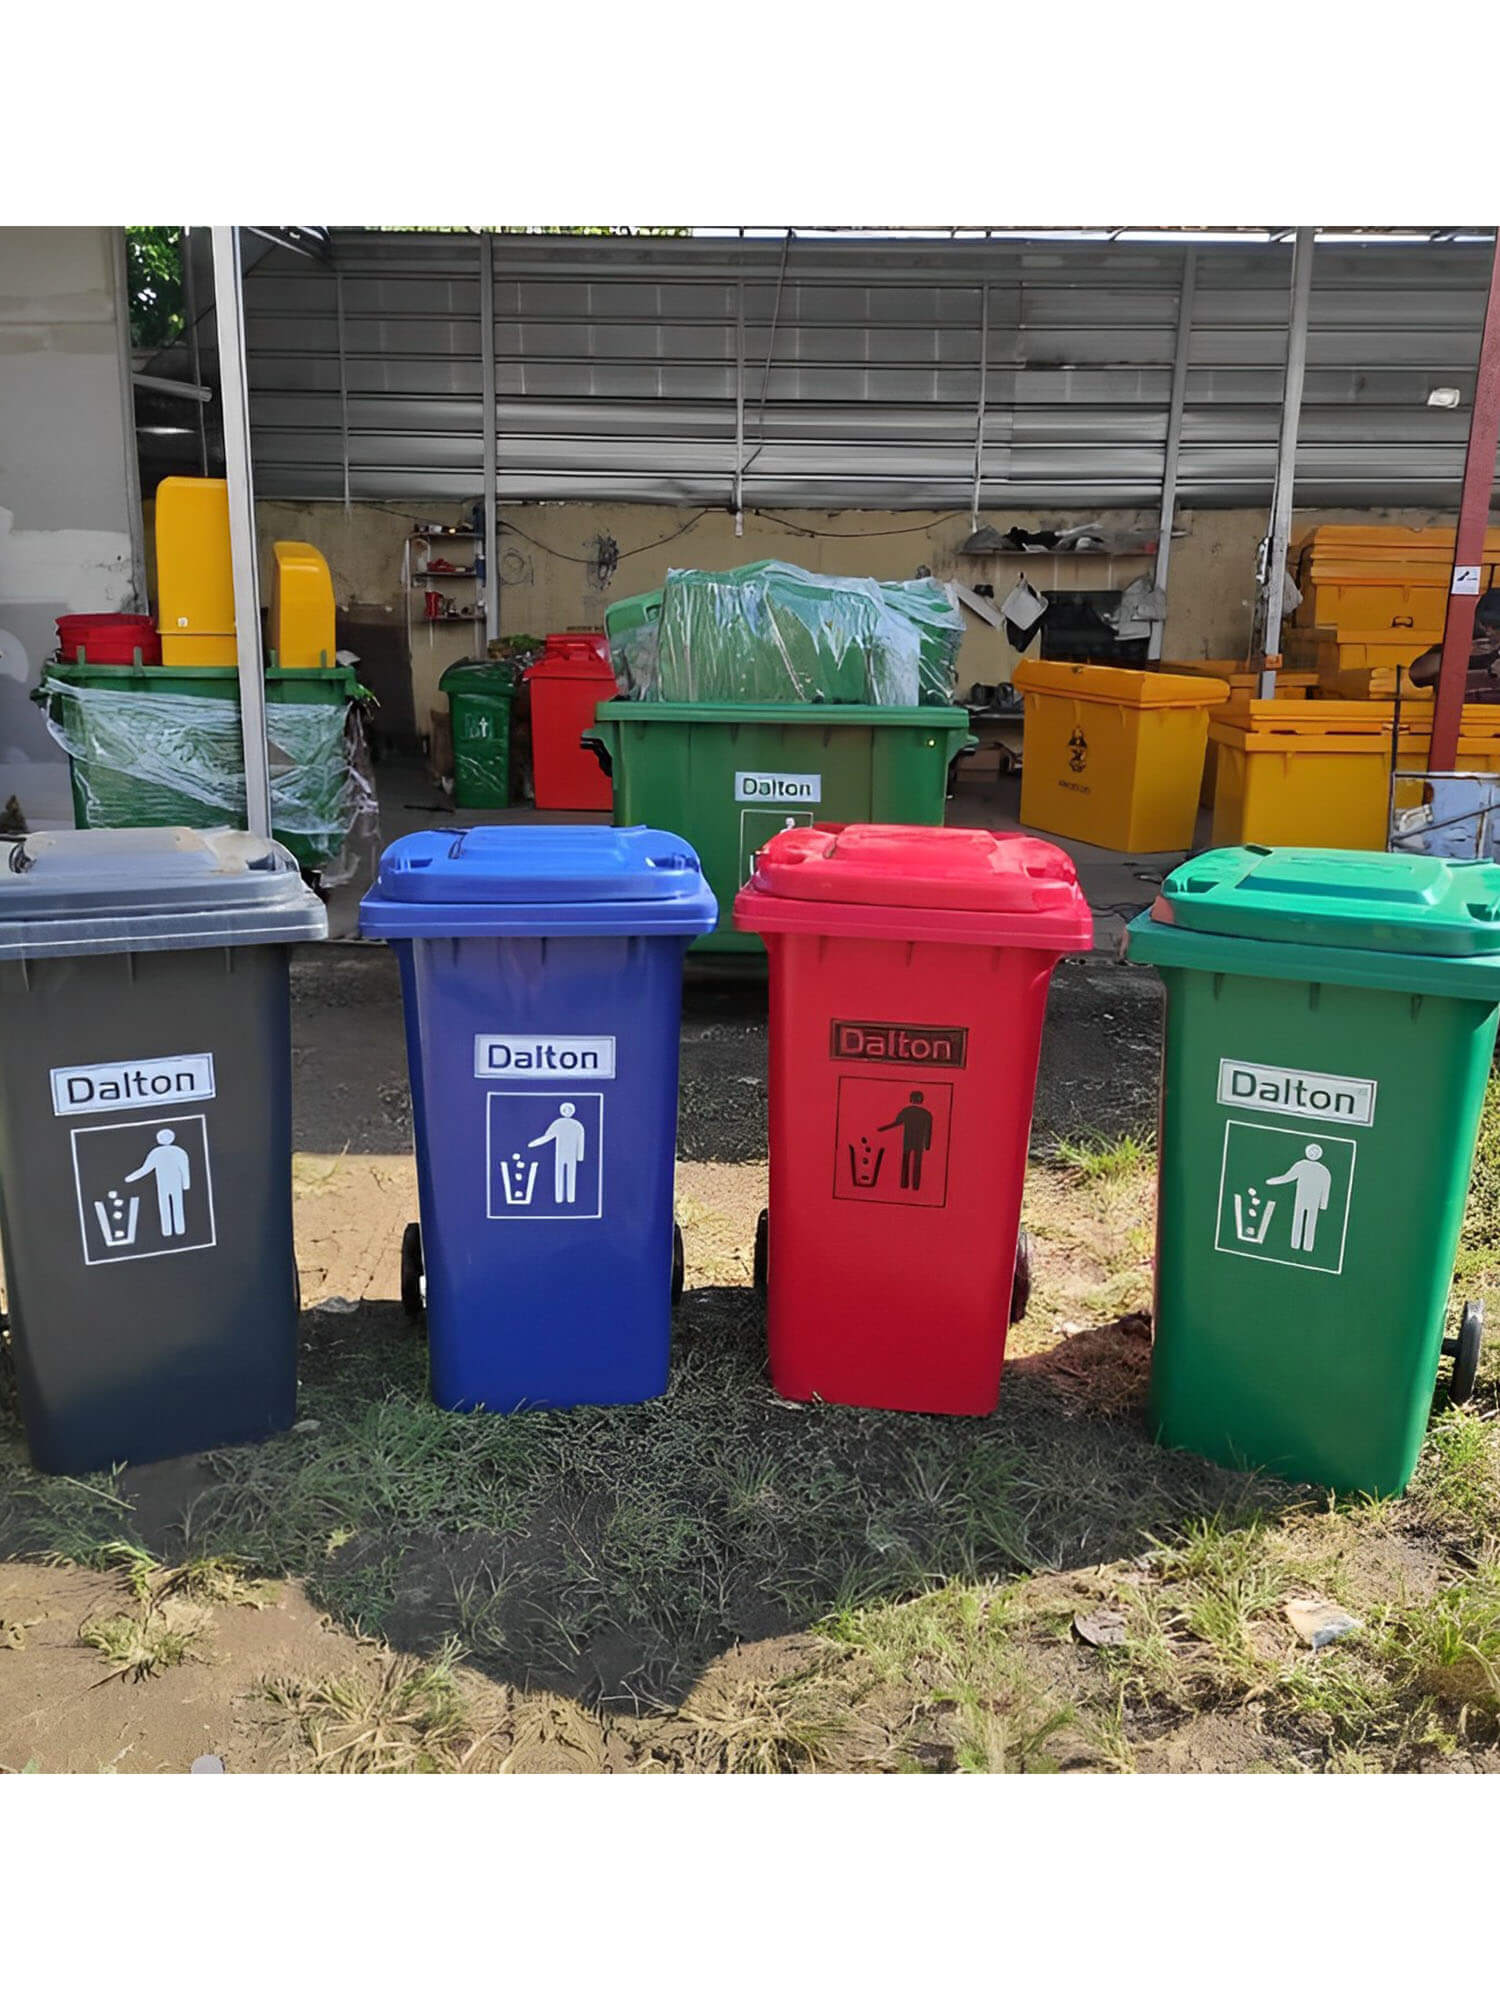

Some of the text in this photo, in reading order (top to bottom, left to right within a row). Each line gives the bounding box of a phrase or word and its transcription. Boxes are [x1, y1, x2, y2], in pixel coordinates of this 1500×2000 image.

[743, 777, 811, 797] Dalton
[487, 1044, 598, 1070] Dalton
[841, 1028, 951, 1060] Dalton
[67, 1070, 195, 1105] Dalton
[1231, 1070, 1355, 1114] Dalton
